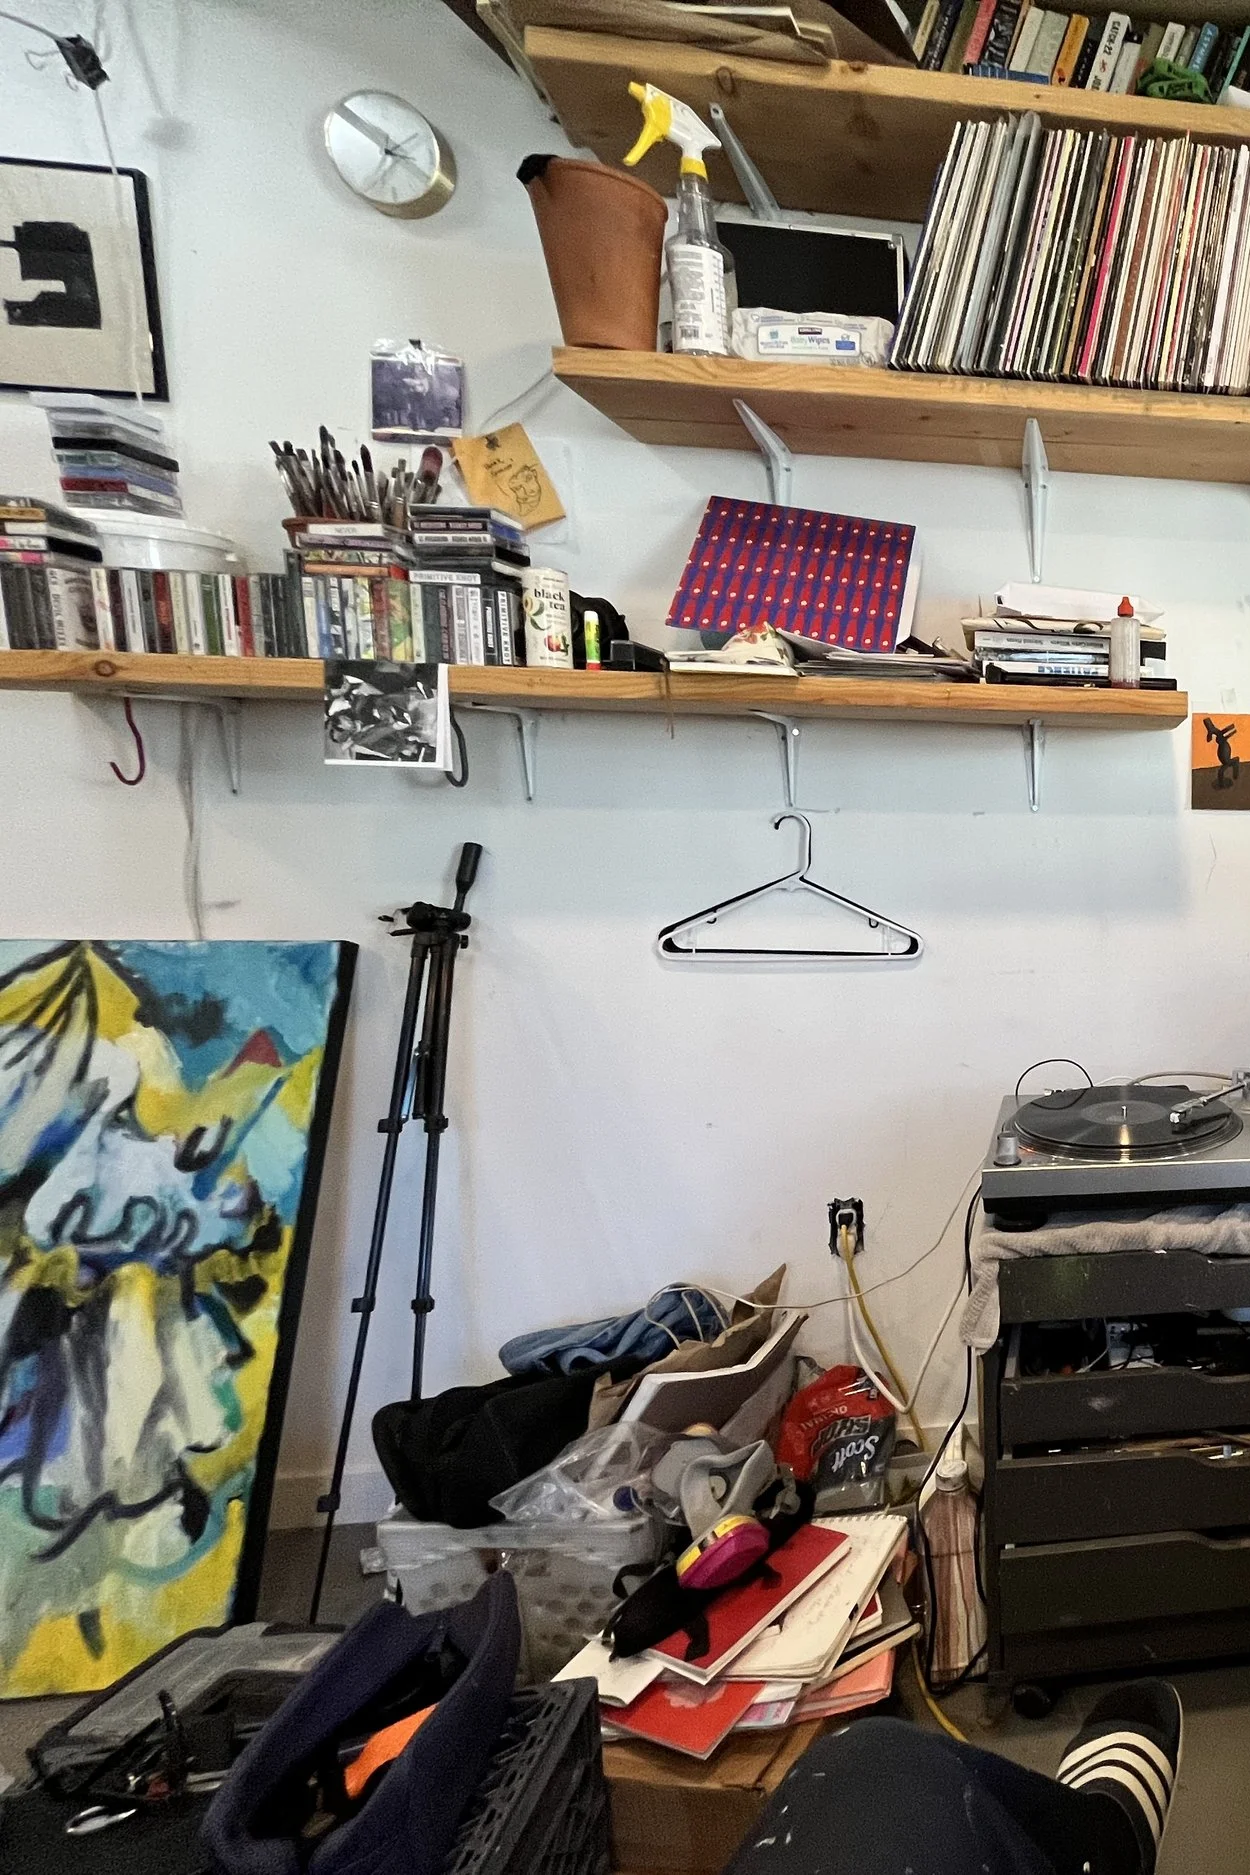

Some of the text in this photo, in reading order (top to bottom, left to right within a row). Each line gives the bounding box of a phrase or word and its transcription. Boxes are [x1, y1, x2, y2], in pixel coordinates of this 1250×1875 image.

[1101, 20, 1121, 56] CATCH-22
[808, 336, 830, 345] Wipes
[534, 588, 565, 601] black
[549, 601, 566, 611] tea
[499, 592, 512, 663] PRIMITIVE KNOT
[831, 1435, 880, 1473] Scott
